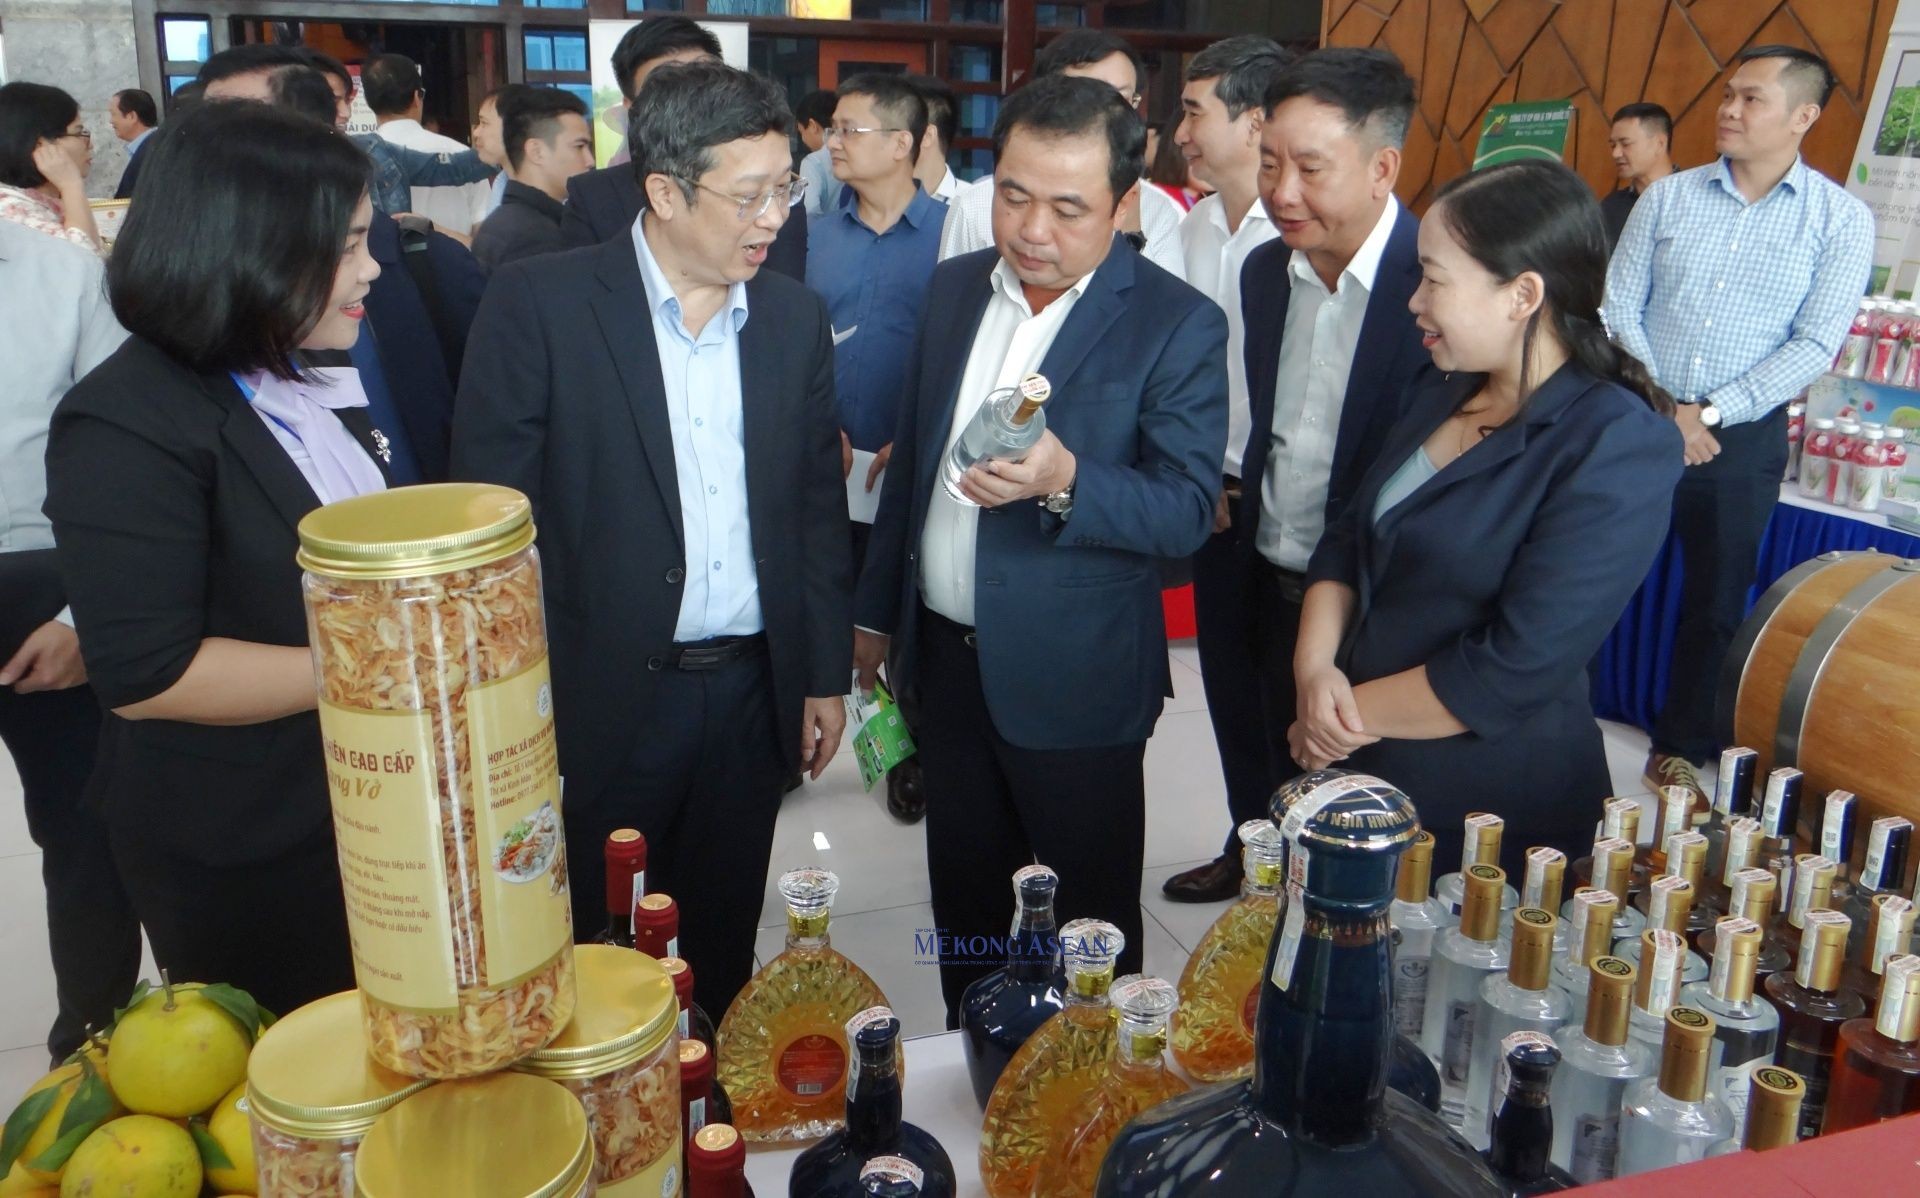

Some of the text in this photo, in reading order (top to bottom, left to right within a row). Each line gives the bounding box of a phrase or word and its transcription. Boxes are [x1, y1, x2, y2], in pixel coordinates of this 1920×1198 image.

[505, 743, 519, 758] TÁC
[349, 749, 378, 772] CAO
[383, 748, 415, 773] CẤP
[1330, 813, 1364, 829] VIÊN
